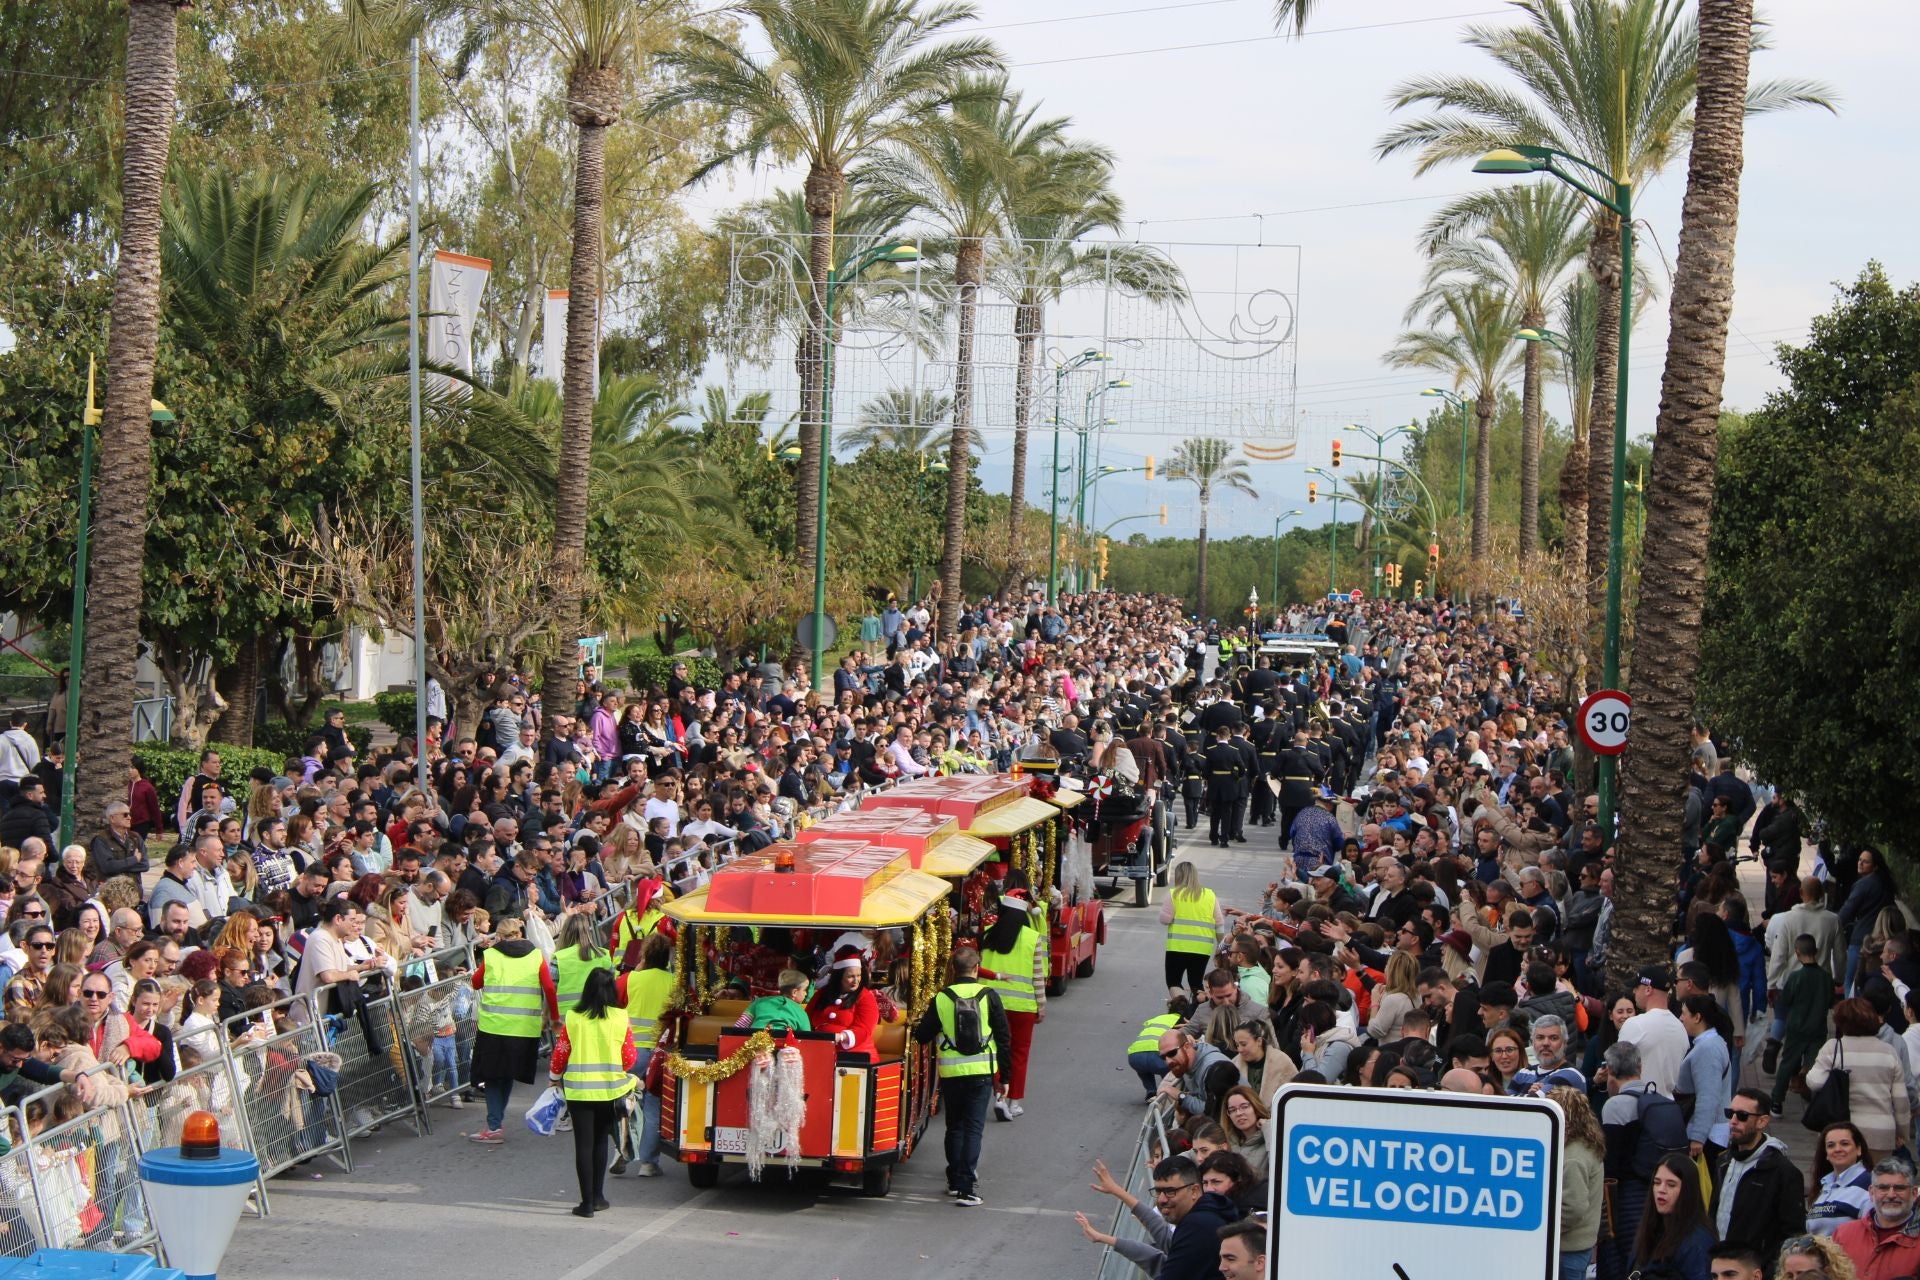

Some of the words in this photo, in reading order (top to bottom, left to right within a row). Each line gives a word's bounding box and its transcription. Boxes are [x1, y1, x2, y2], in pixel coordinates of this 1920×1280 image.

[1591, 711, 1629, 733] 30
[716, 1139, 747, 1151] 85553
[1296, 1135, 1475, 1175] CONTROL
[1490, 1147, 1536, 1179] DE
[1305, 1176, 1524, 1219] VELOCIDAD
